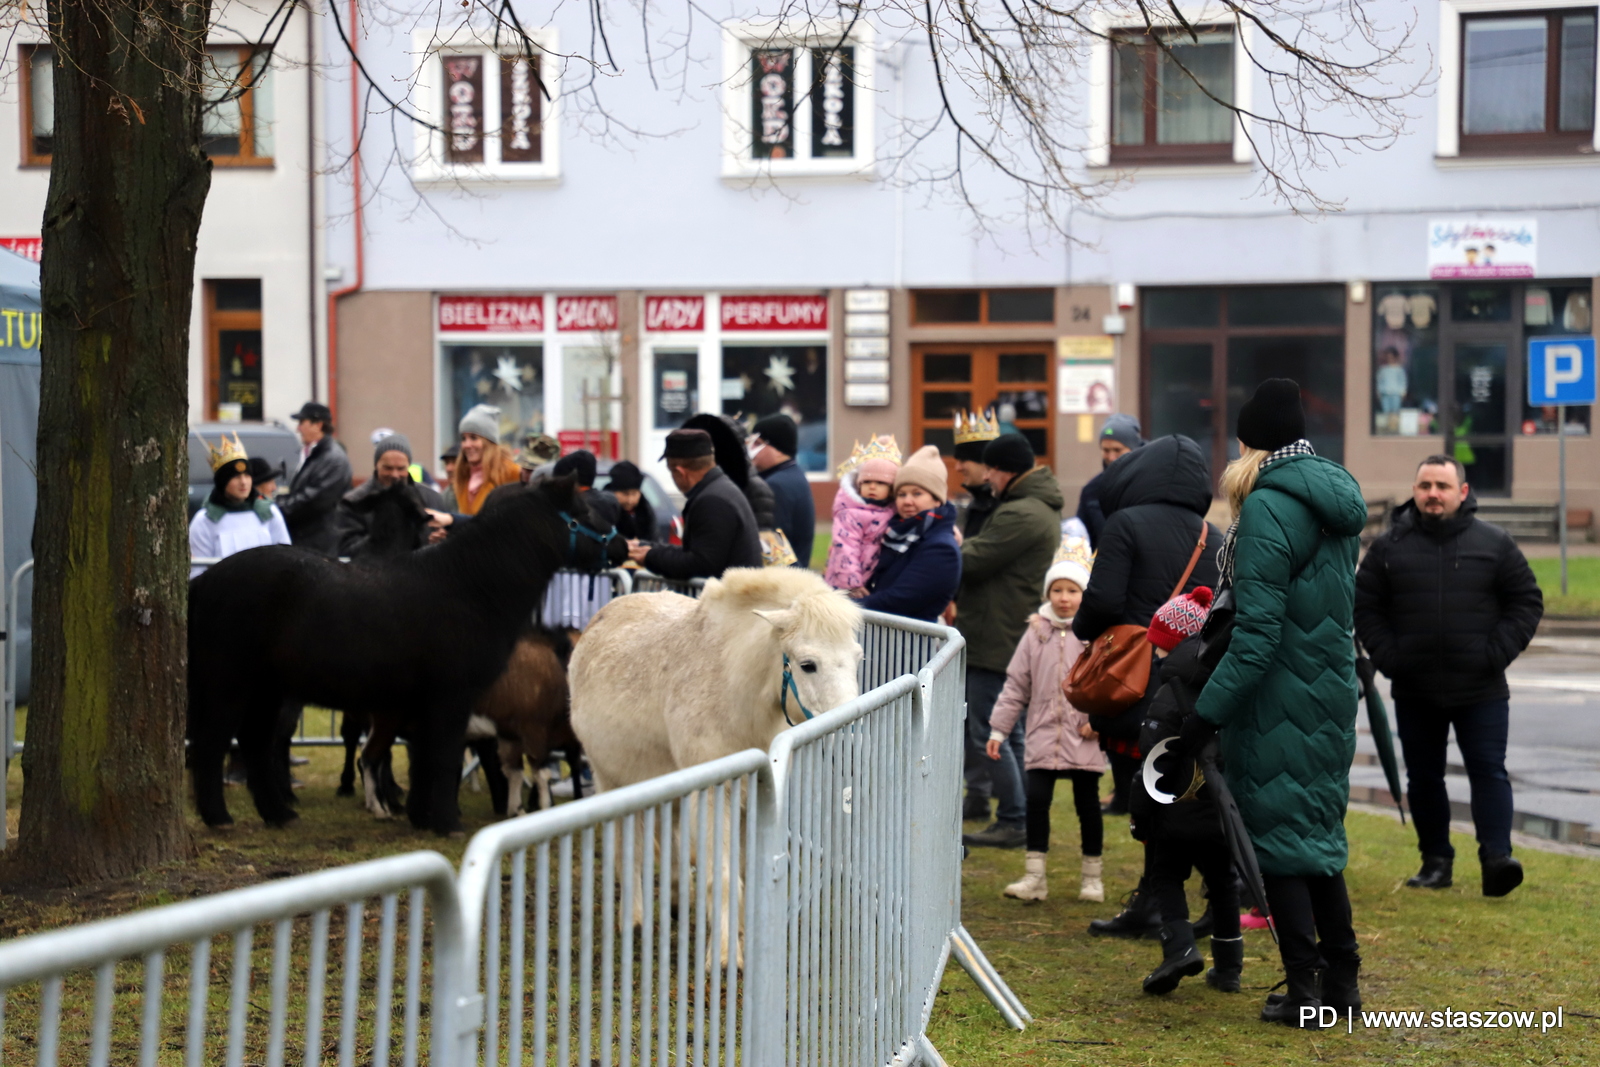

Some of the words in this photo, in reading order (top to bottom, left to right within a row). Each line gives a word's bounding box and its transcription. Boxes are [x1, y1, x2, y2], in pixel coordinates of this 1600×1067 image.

[440, 302, 542, 325] BIELIZNA
[558, 299, 616, 329] SALON
[647, 299, 703, 329] LADY
[722, 302, 826, 325] PERFUMY
[1545, 344, 1583, 398] P
